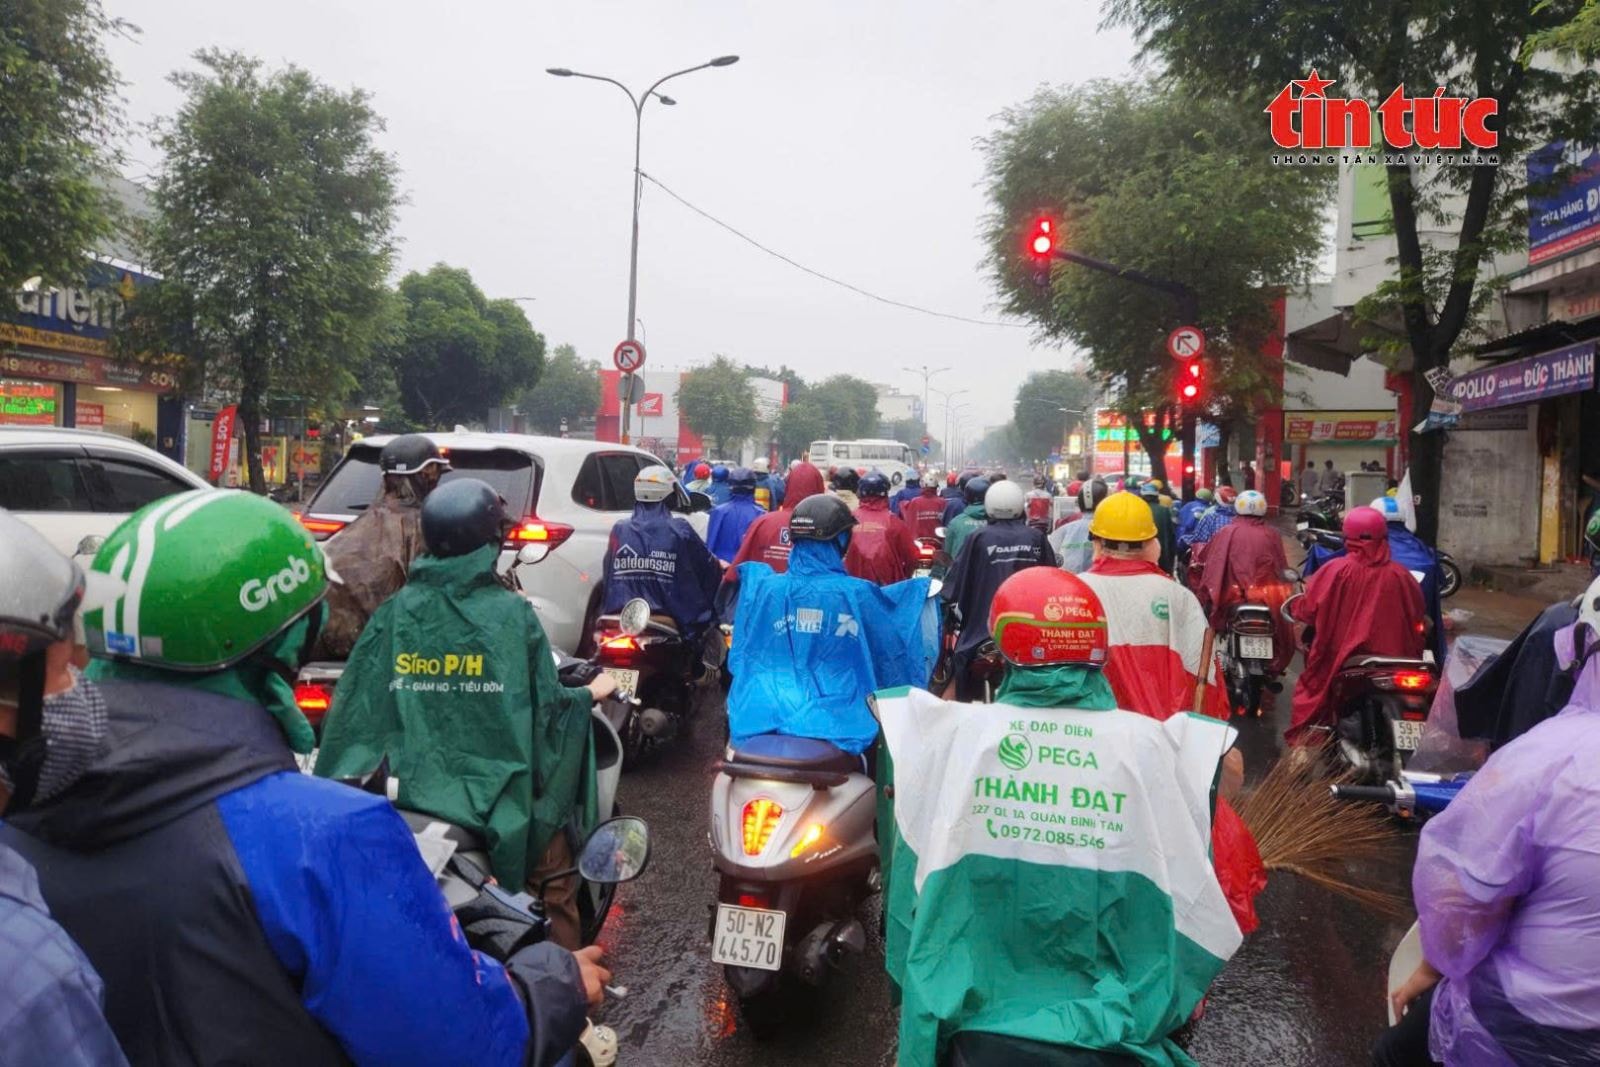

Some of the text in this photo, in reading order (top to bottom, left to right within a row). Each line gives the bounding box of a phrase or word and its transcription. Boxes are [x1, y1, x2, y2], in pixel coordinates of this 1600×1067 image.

[1560, 199, 1584, 220] HÀNG
[1524, 361, 1549, 387] ĐỨC
[1552, 352, 1595, 381] THÀNH
[213, 441, 227, 473] SALE
[996, 545, 1032, 553] DAIKIN
[239, 555, 310, 612] Grab
[1065, 607, 1093, 618] PEGA
[444, 654, 484, 677] P/H
[1009, 720, 1025, 731] XE
[1038, 745, 1099, 770] PEGA
[974, 774, 1127, 817] THÀNH ĐẠT
[1000, 824, 1105, 850] 0972.085.546
[726, 910, 775, 938] 50-N2
[718, 935, 777, 965] 445.70
